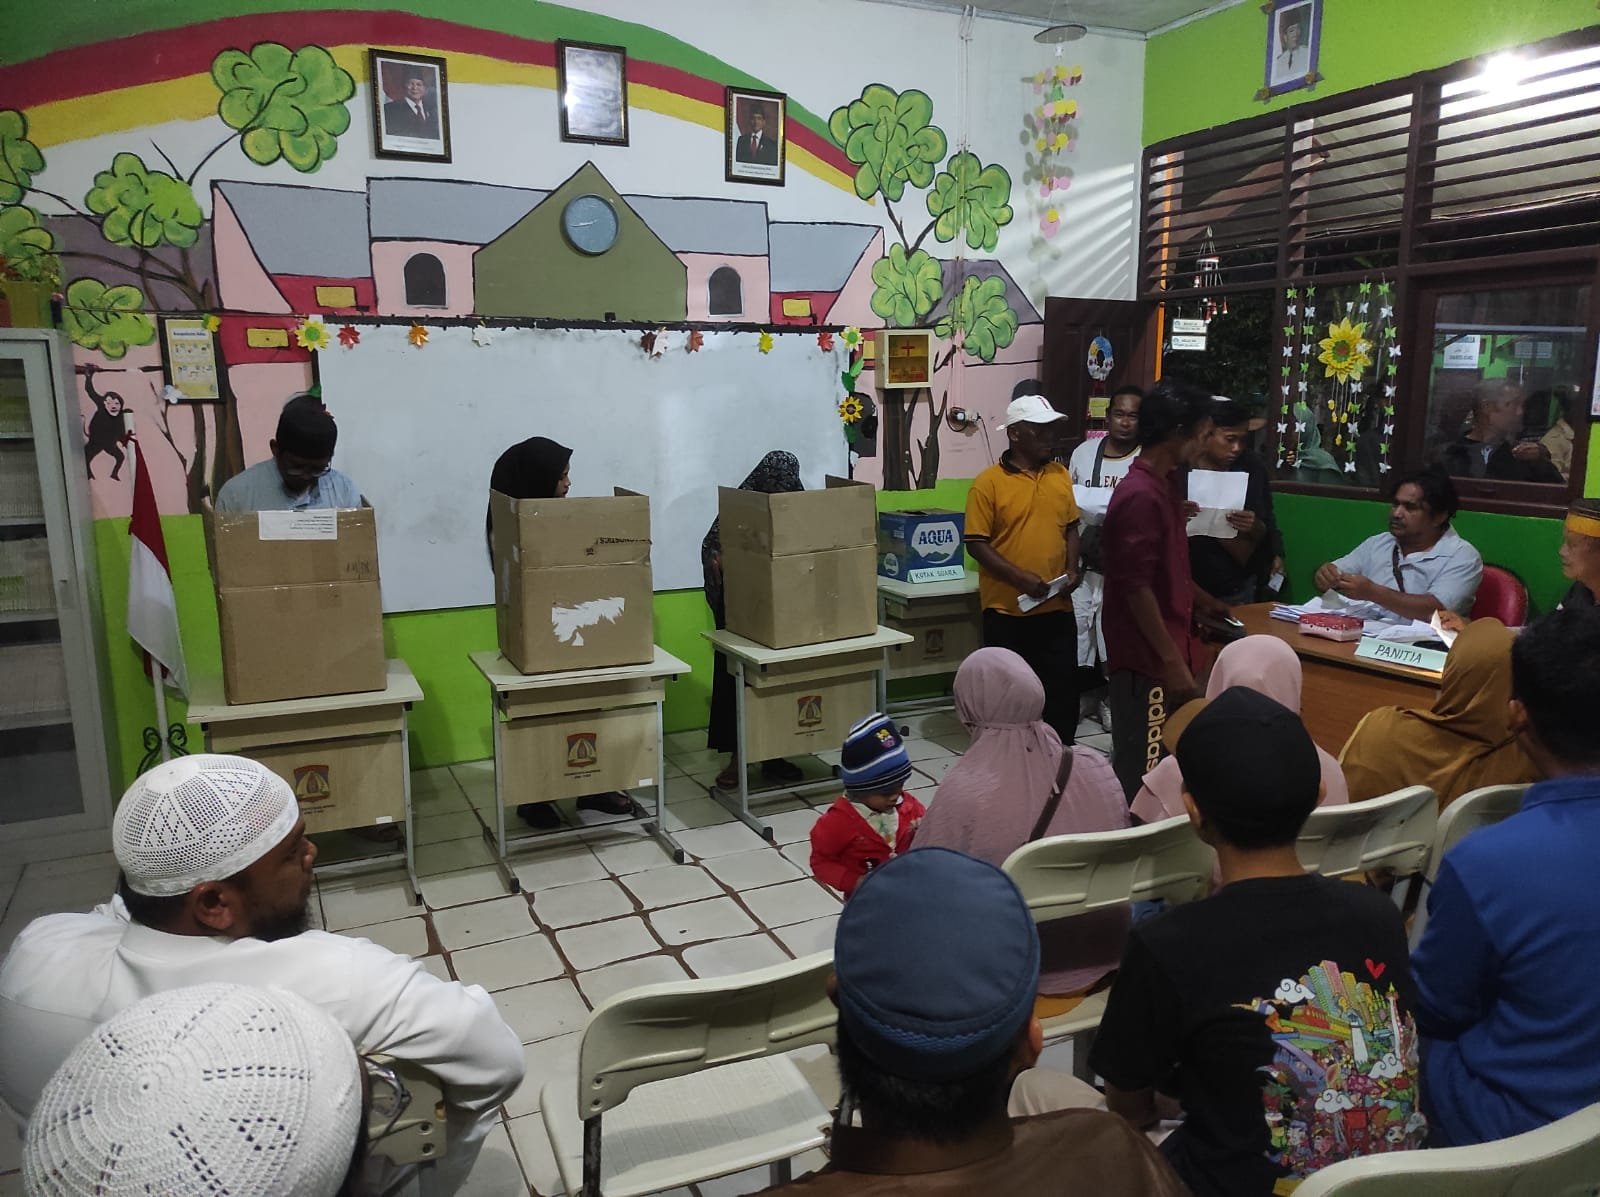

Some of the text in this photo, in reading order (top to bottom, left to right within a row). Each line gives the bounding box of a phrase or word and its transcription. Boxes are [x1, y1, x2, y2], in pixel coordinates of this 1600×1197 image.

[918, 528, 954, 546] AQUA
[915, 571, 935, 580] KOTAK
[1374, 643, 1423, 664] PANITIA
